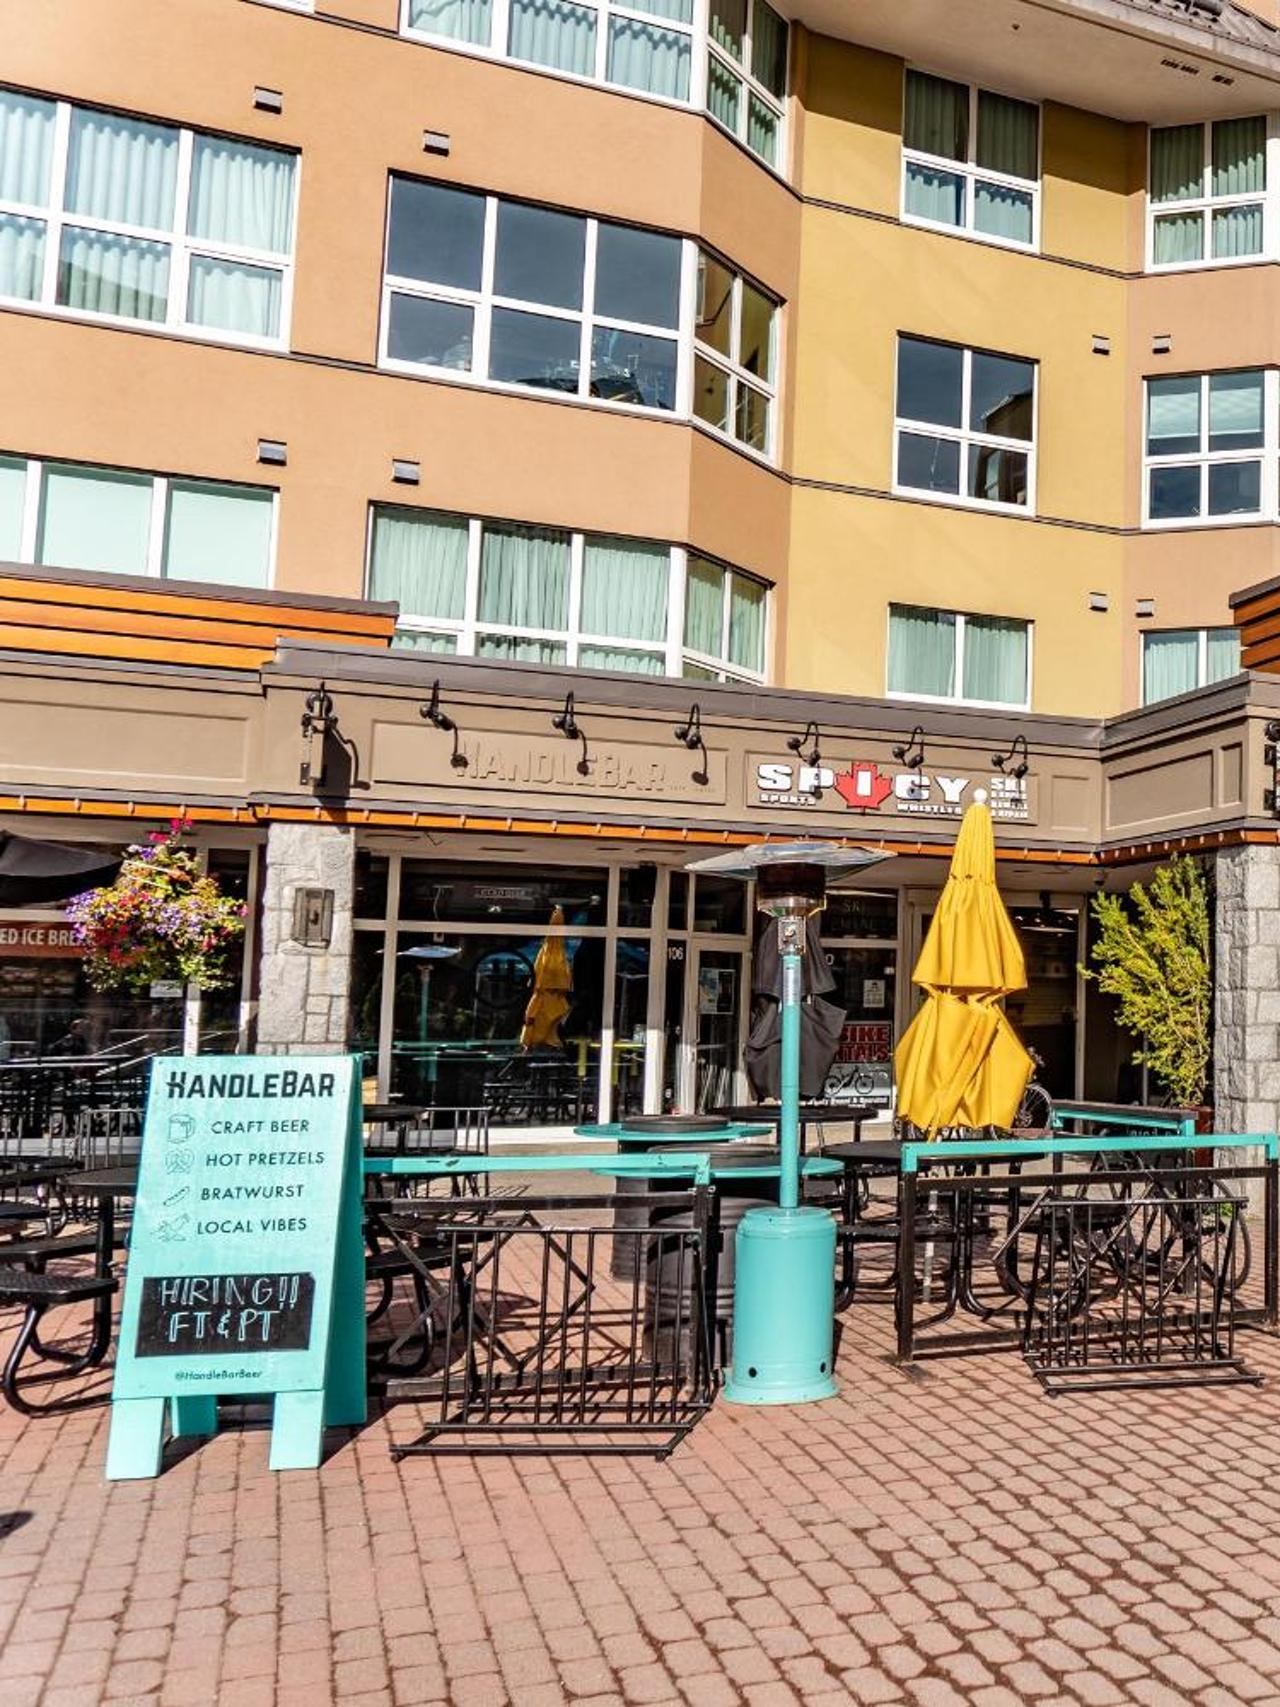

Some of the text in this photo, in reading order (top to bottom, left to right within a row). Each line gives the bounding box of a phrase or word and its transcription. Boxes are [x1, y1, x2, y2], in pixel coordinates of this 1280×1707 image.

[756, 763, 970, 803] SPICY
[21, 928, 45, 945] ICE
[668, 946, 684, 960] 106
[211, 1119, 310, 1134] CRAFT BEER
[206, 1151, 325, 1167] HOT PRETZELS
[201, 1184, 305, 1201] BRATWURST
[197, 1217, 308, 1235] LOCAL VIBES
[168, 1308, 281, 1343] FT & PT
